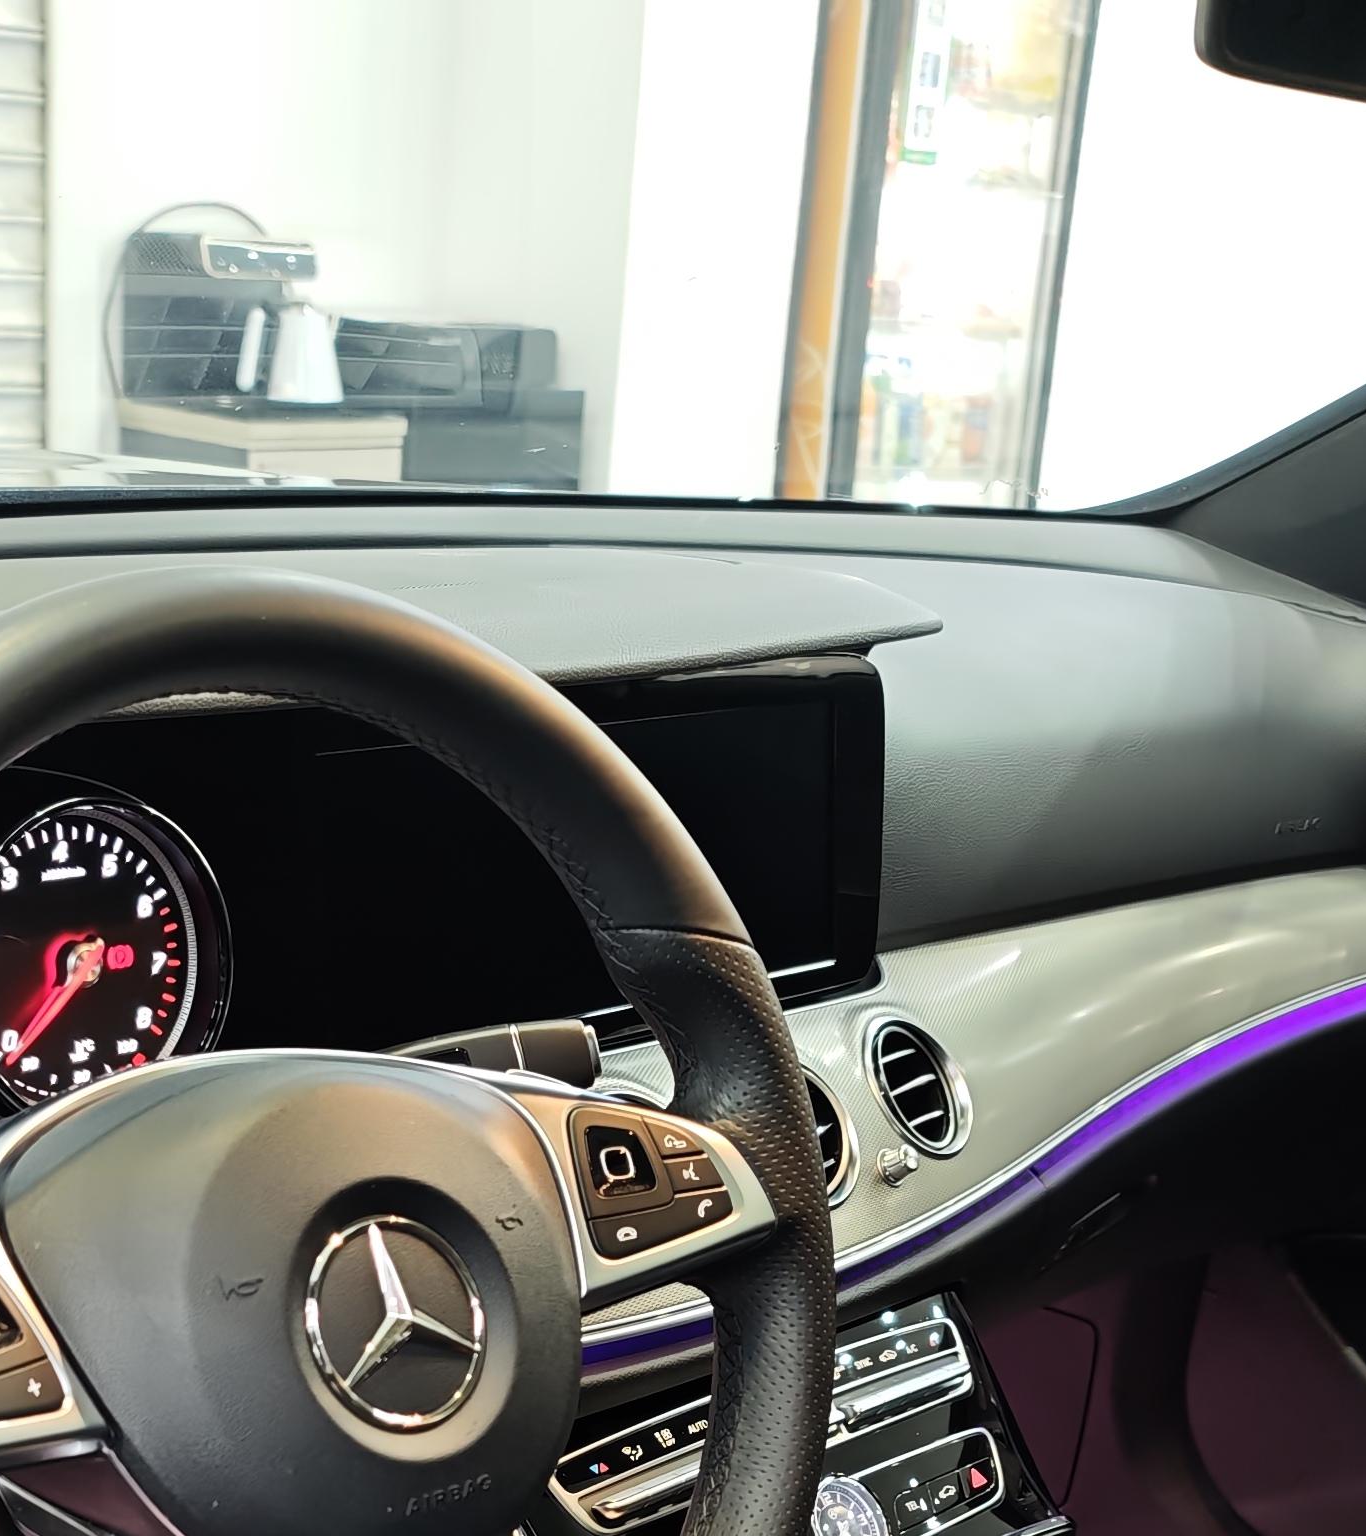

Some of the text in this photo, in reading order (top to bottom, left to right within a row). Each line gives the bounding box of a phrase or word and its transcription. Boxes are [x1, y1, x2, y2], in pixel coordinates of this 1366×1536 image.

[51, 840, 69, 863] 4
[101, 853, 119, 878] 5
[0, 866, 19, 891] 3
[136, 894, 154, 919] 6
[151, 952, 169, 976] 7
[136, 1007, 153, 1031] 8
[2, 1030, 19, 1053] 0
[687, 1419, 709, 1435] AUTO
[404, 1473, 494, 1517] AIRBAG
